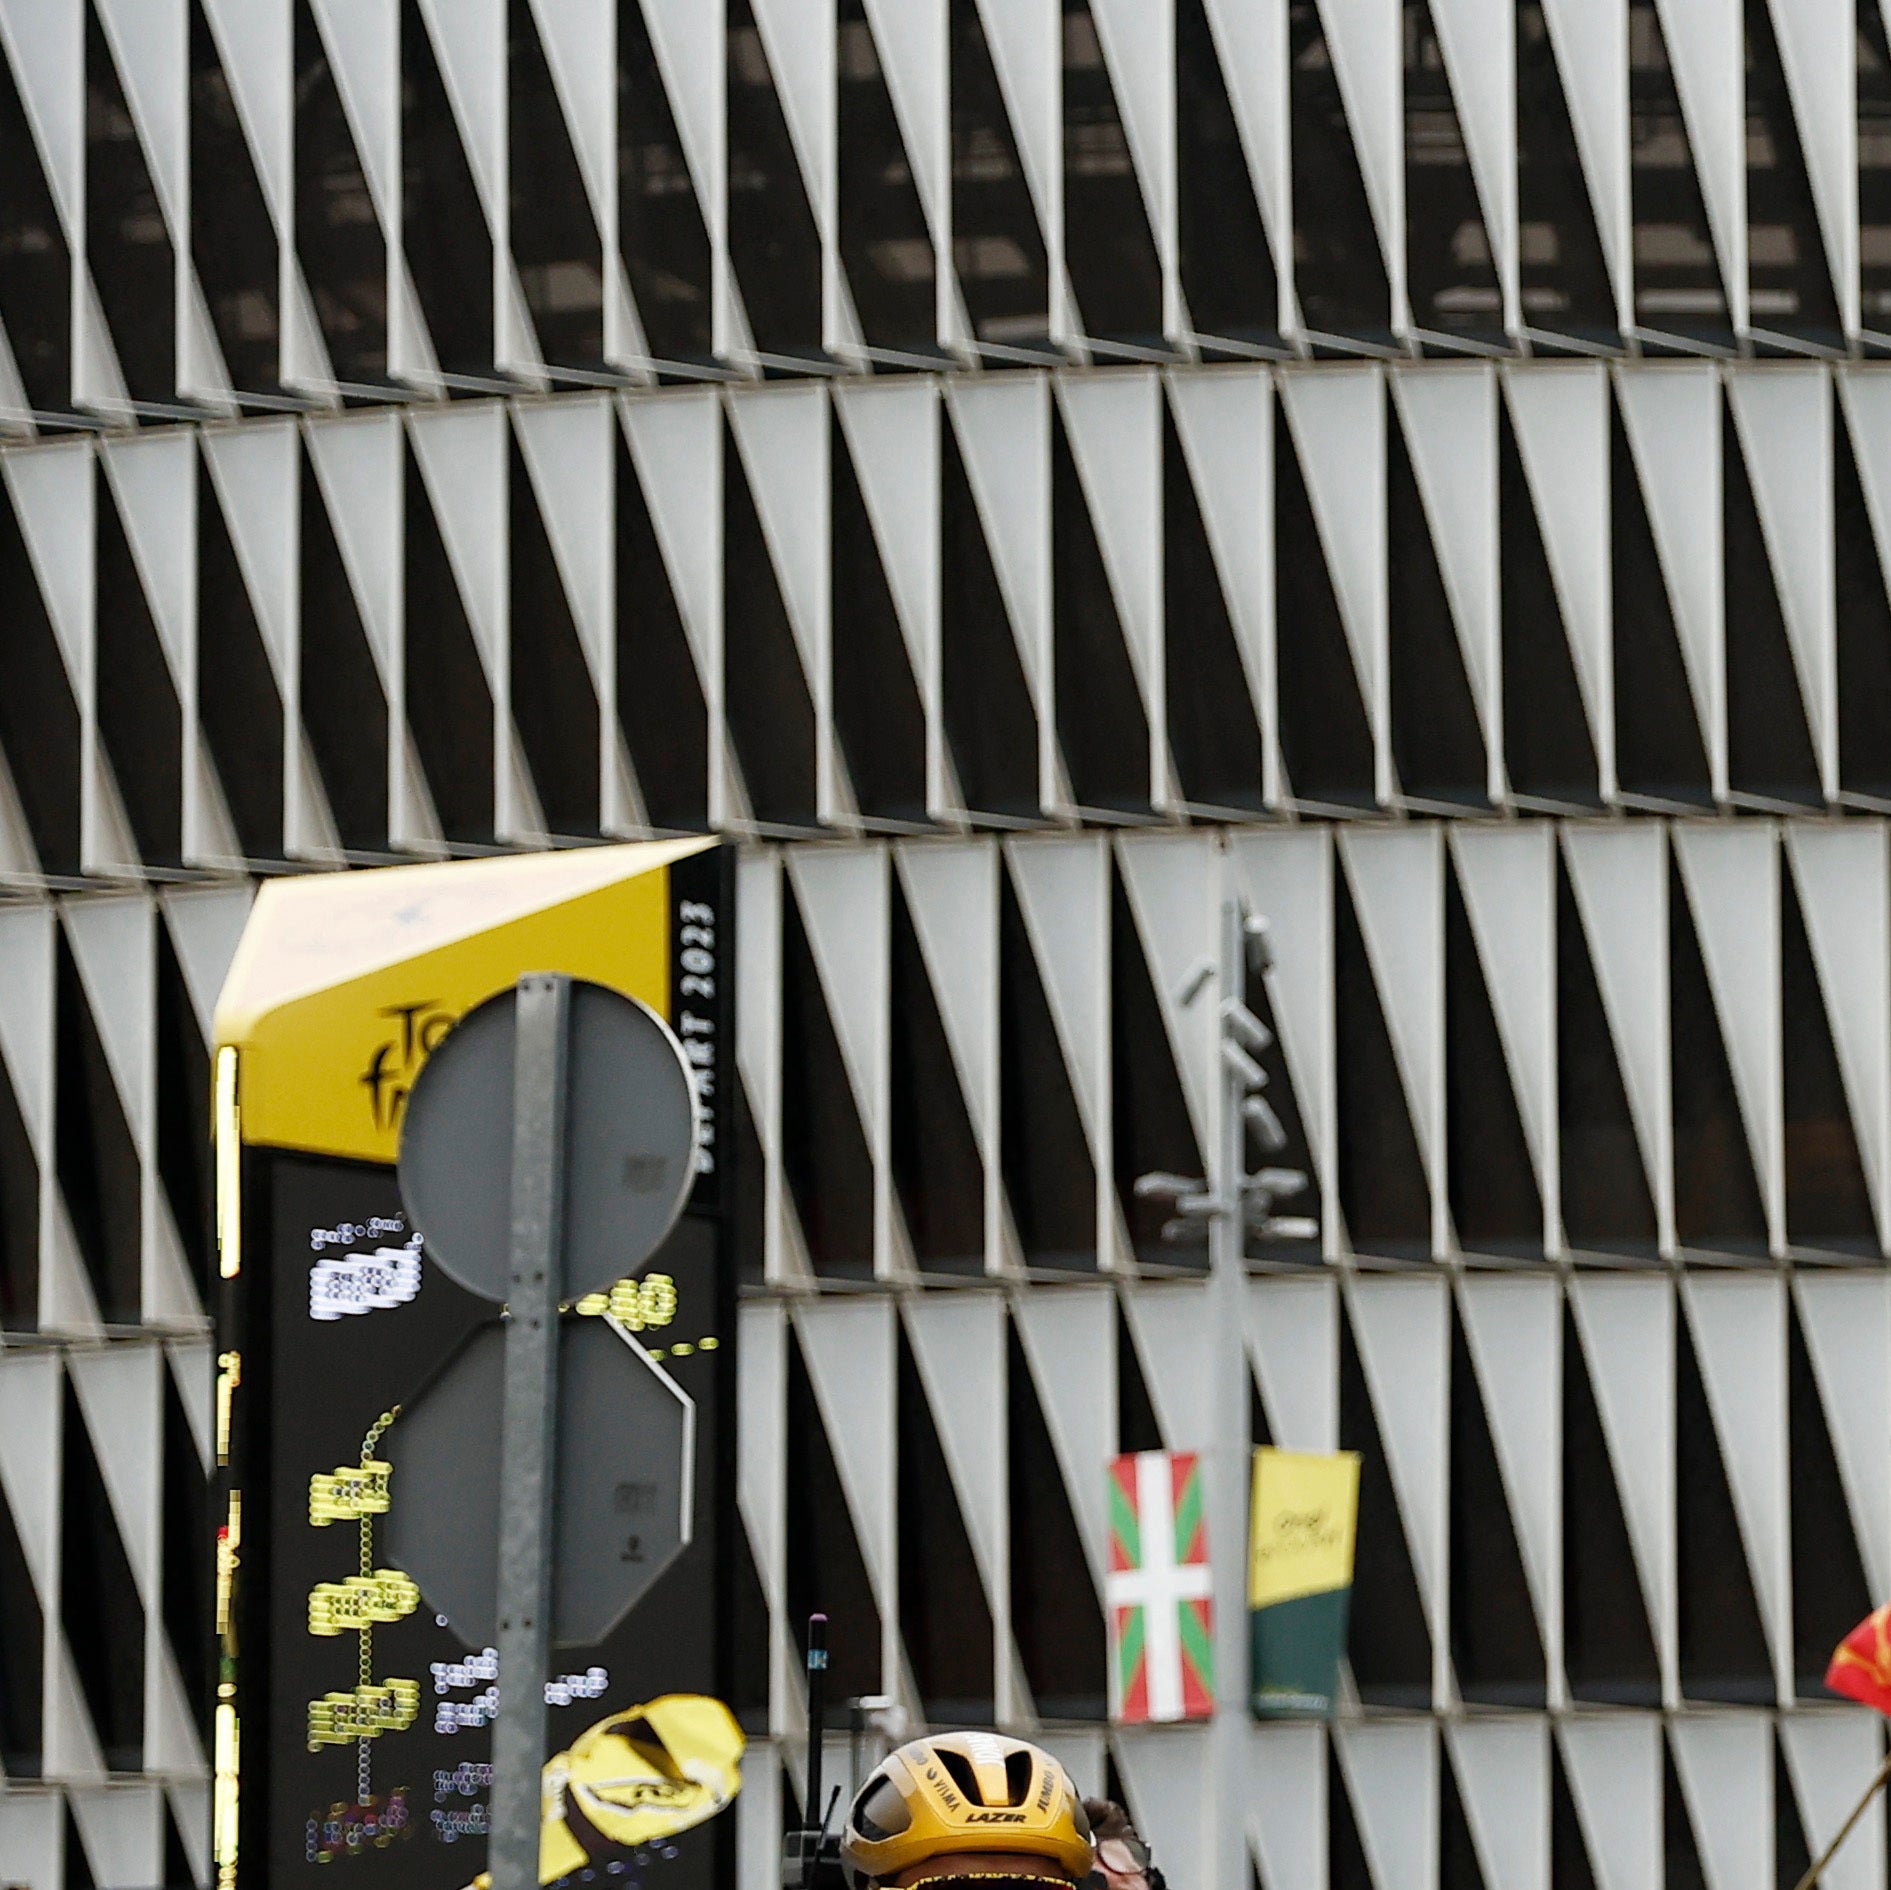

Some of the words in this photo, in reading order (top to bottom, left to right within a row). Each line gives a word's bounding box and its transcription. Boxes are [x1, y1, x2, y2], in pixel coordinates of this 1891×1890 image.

[680, 900, 716, 999] 2023
[932, 1780, 962, 1813] VISMA
[1037, 1770, 1056, 1815] JUMBO
[964, 1812, 1028, 1824] LAZER
